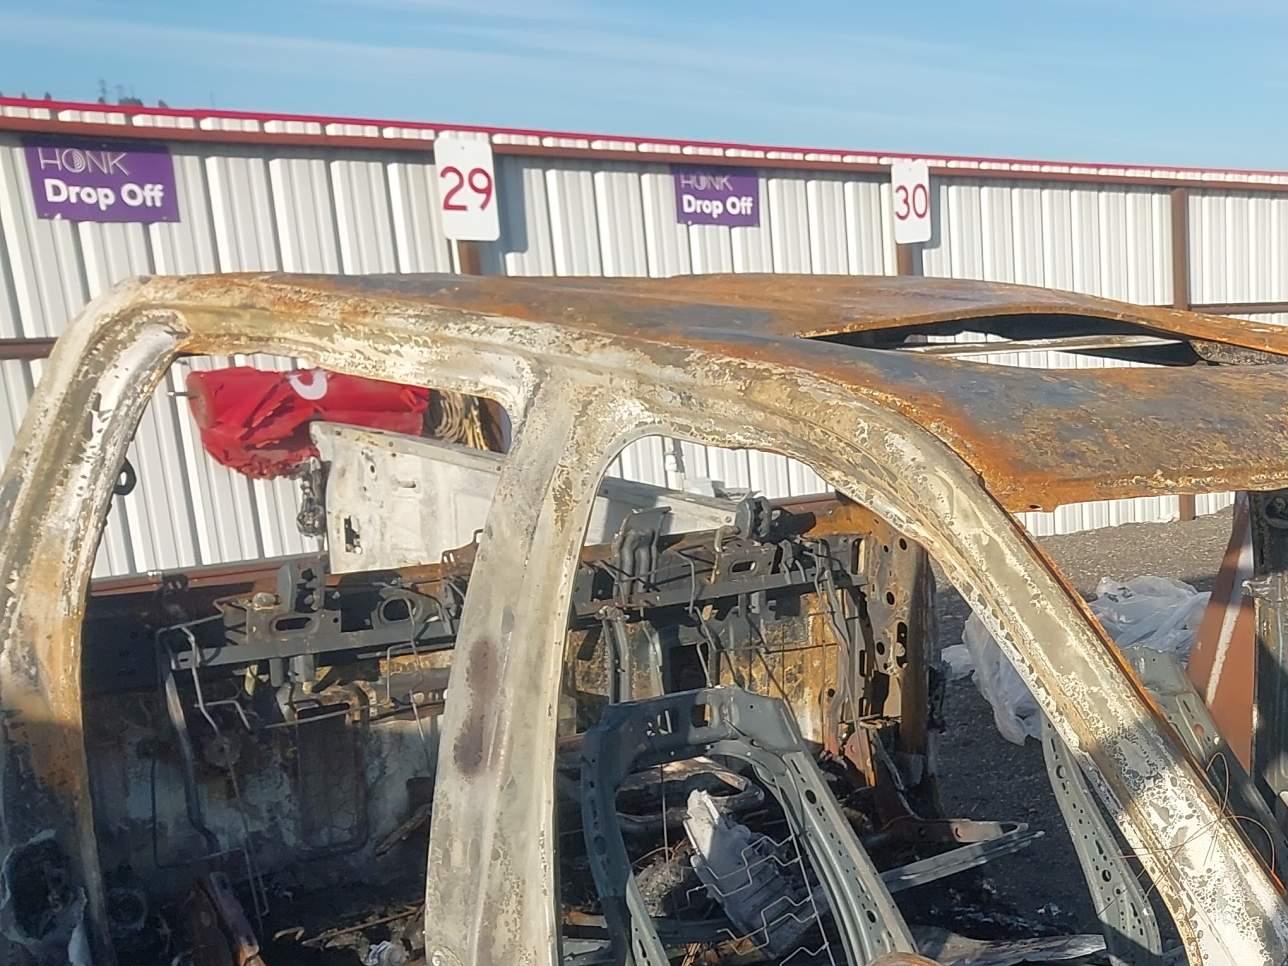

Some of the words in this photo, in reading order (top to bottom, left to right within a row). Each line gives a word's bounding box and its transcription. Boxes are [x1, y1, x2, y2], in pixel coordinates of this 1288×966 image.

[37, 147, 130, 176] HONK
[44, 178, 116, 211] Drop
[121, 183, 164, 207] Off
[440, 166, 492, 211] 29
[895, 184, 928, 220] 30
[682, 194, 723, 218] Drop
[726, 196, 753, 215] Off
